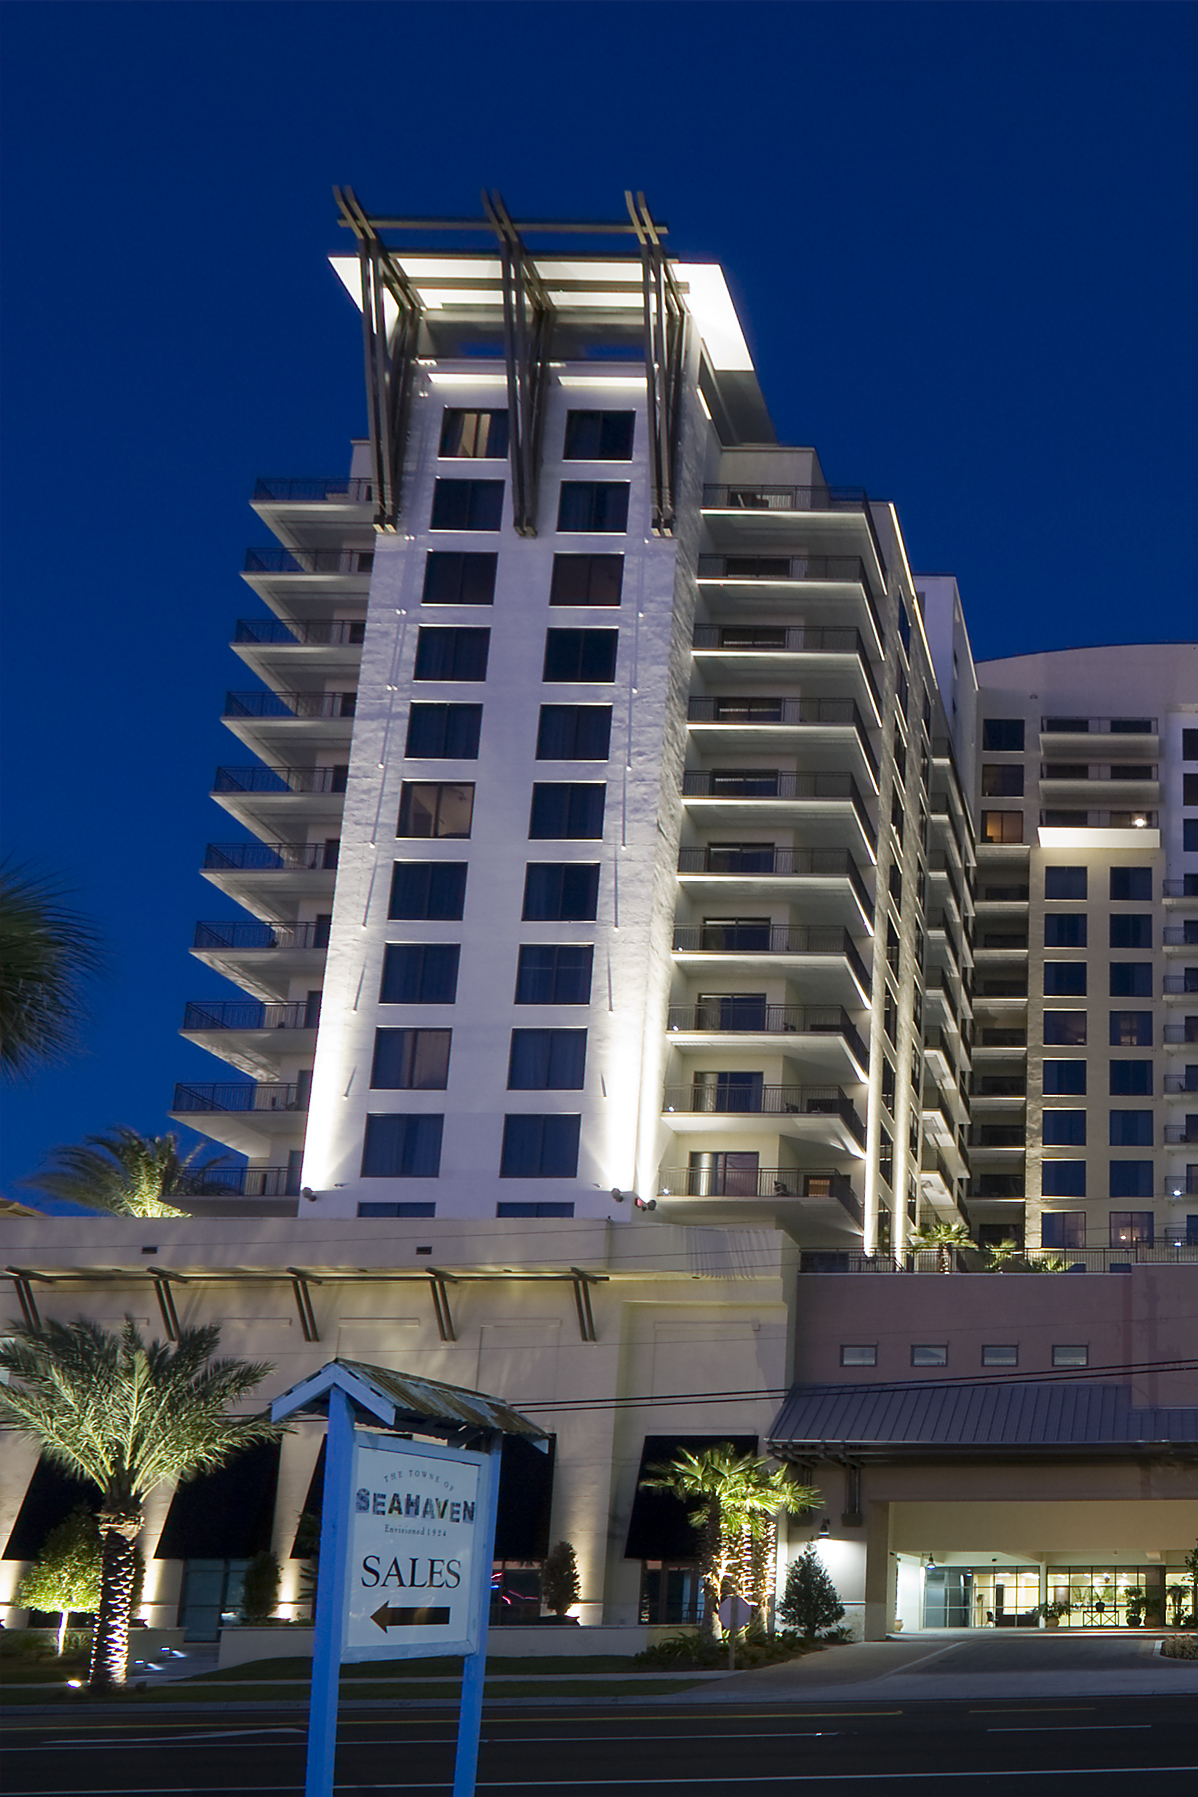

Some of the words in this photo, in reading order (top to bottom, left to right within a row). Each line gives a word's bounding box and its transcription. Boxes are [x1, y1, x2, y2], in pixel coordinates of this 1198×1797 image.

[384, 1471, 403, 1483] THE
[409, 1470, 440, 1483] TOWNE
[356, 1488, 475, 1524] SEAHAVEN
[361, 1555, 461, 1588] SALES
